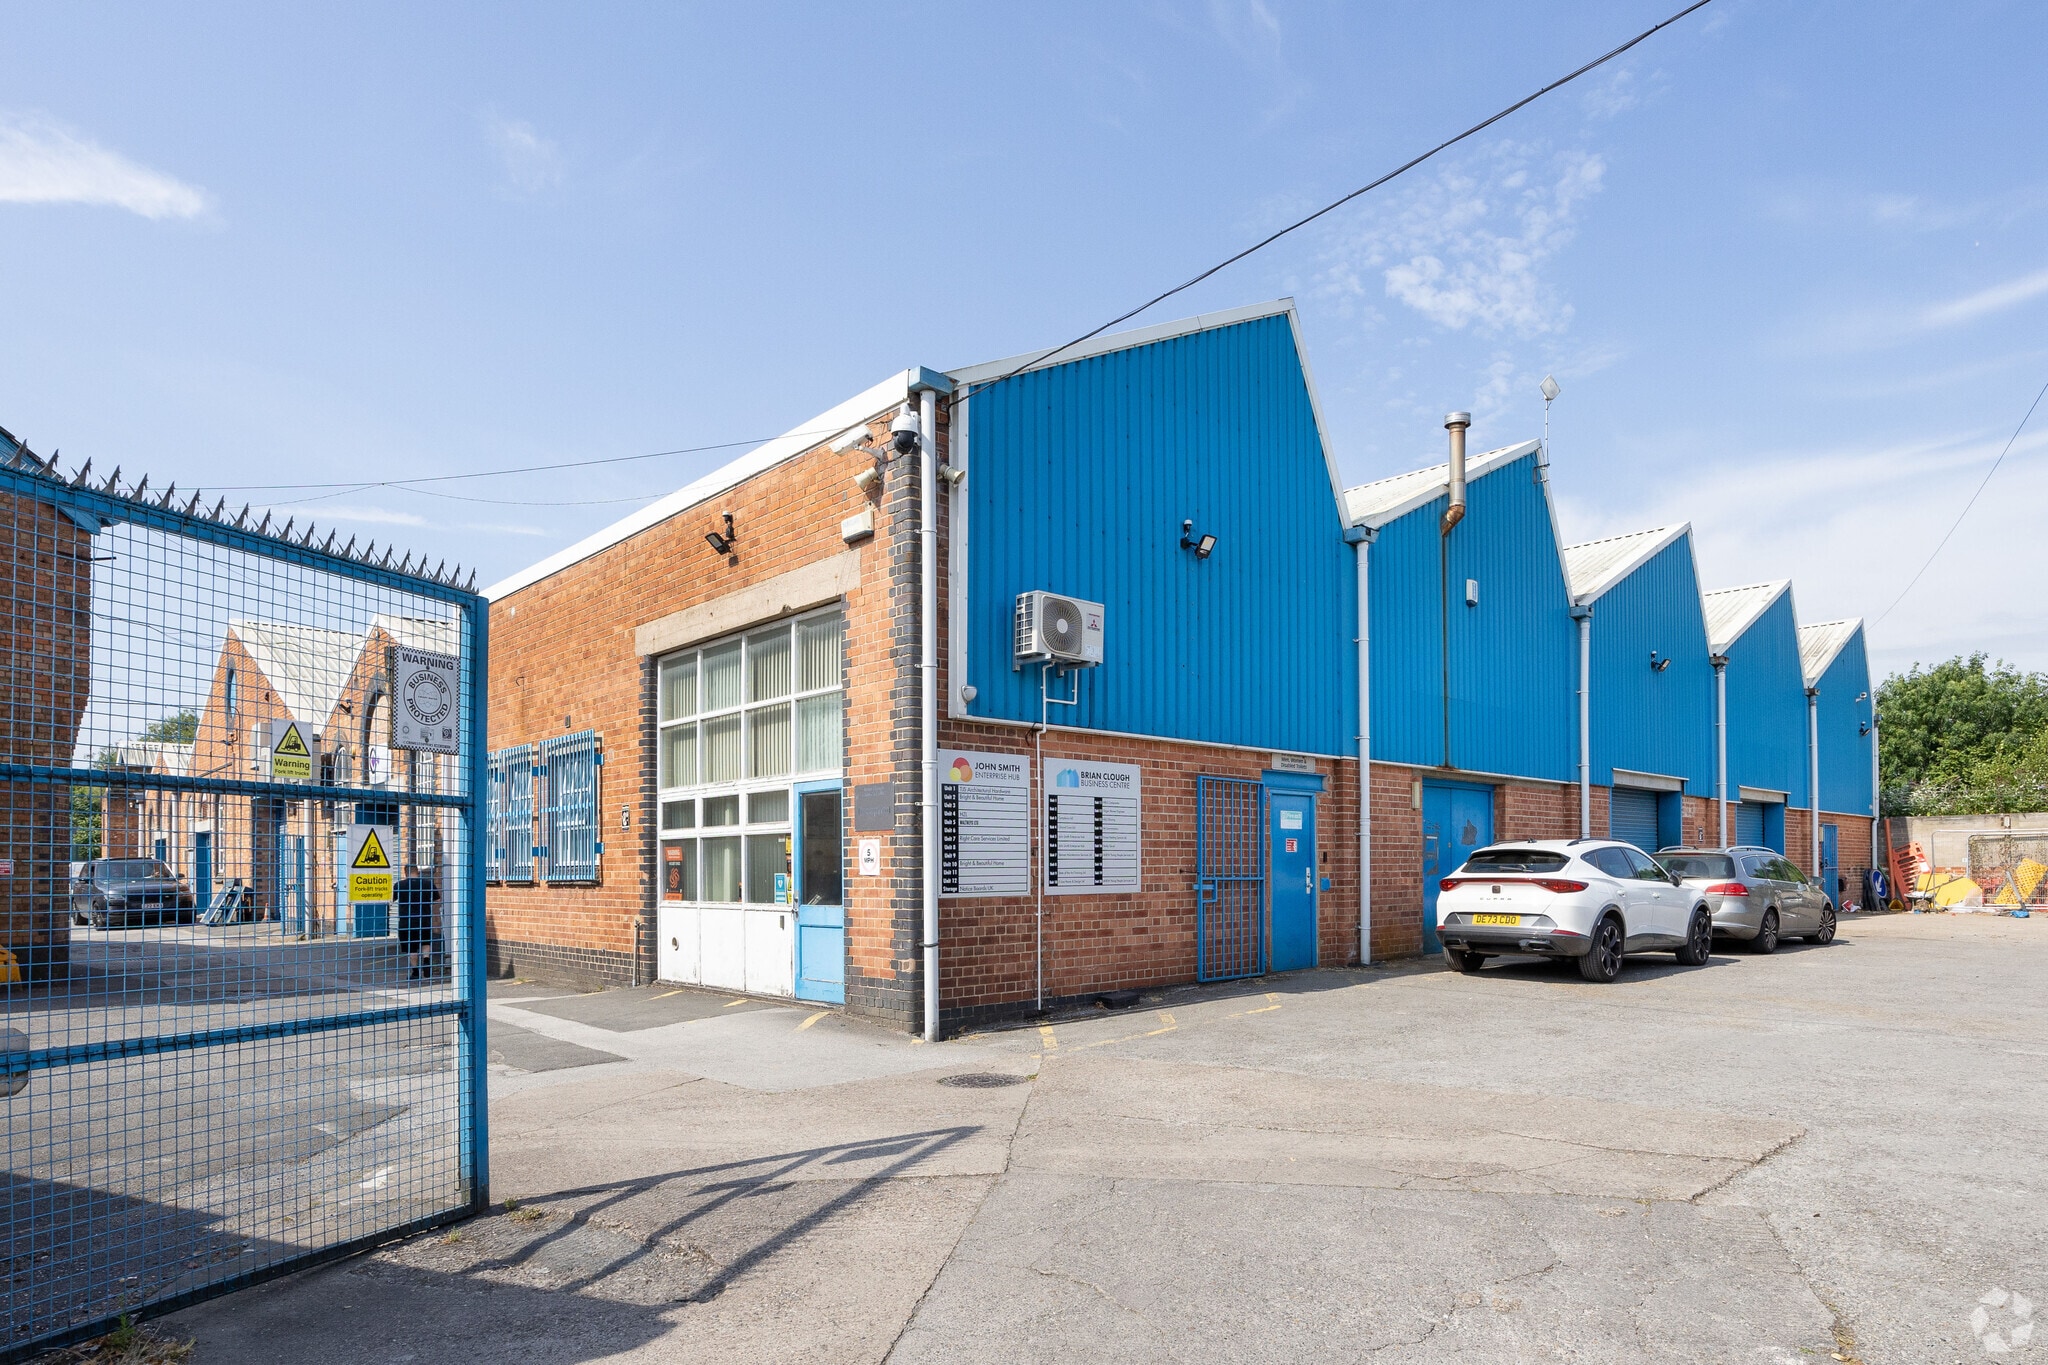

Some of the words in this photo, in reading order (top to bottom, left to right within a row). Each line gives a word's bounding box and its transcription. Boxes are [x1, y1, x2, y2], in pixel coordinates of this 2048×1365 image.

[401, 652, 454, 671] WARNING
[408, 672, 448, 694] BUSINESS
[406, 697, 448, 723] PROTECTED
[274, 758, 310, 770] Warning
[974, 762, 997, 770] JOHN
[998, 764, 1020, 772] SMITH
[974, 772, 1007, 780] ENTERPRISE
[1080, 771, 1102, 780] BRIAN
[1102, 773, 1130, 781] CLOUGH
[1080, 780, 1108, 788] BUSINESS
[866, 848, 871, 856] 5
[356, 876, 388, 885] Caution
[1476, 915, 1498, 924] DE73
[1500, 916, 1517, 924] CDO
